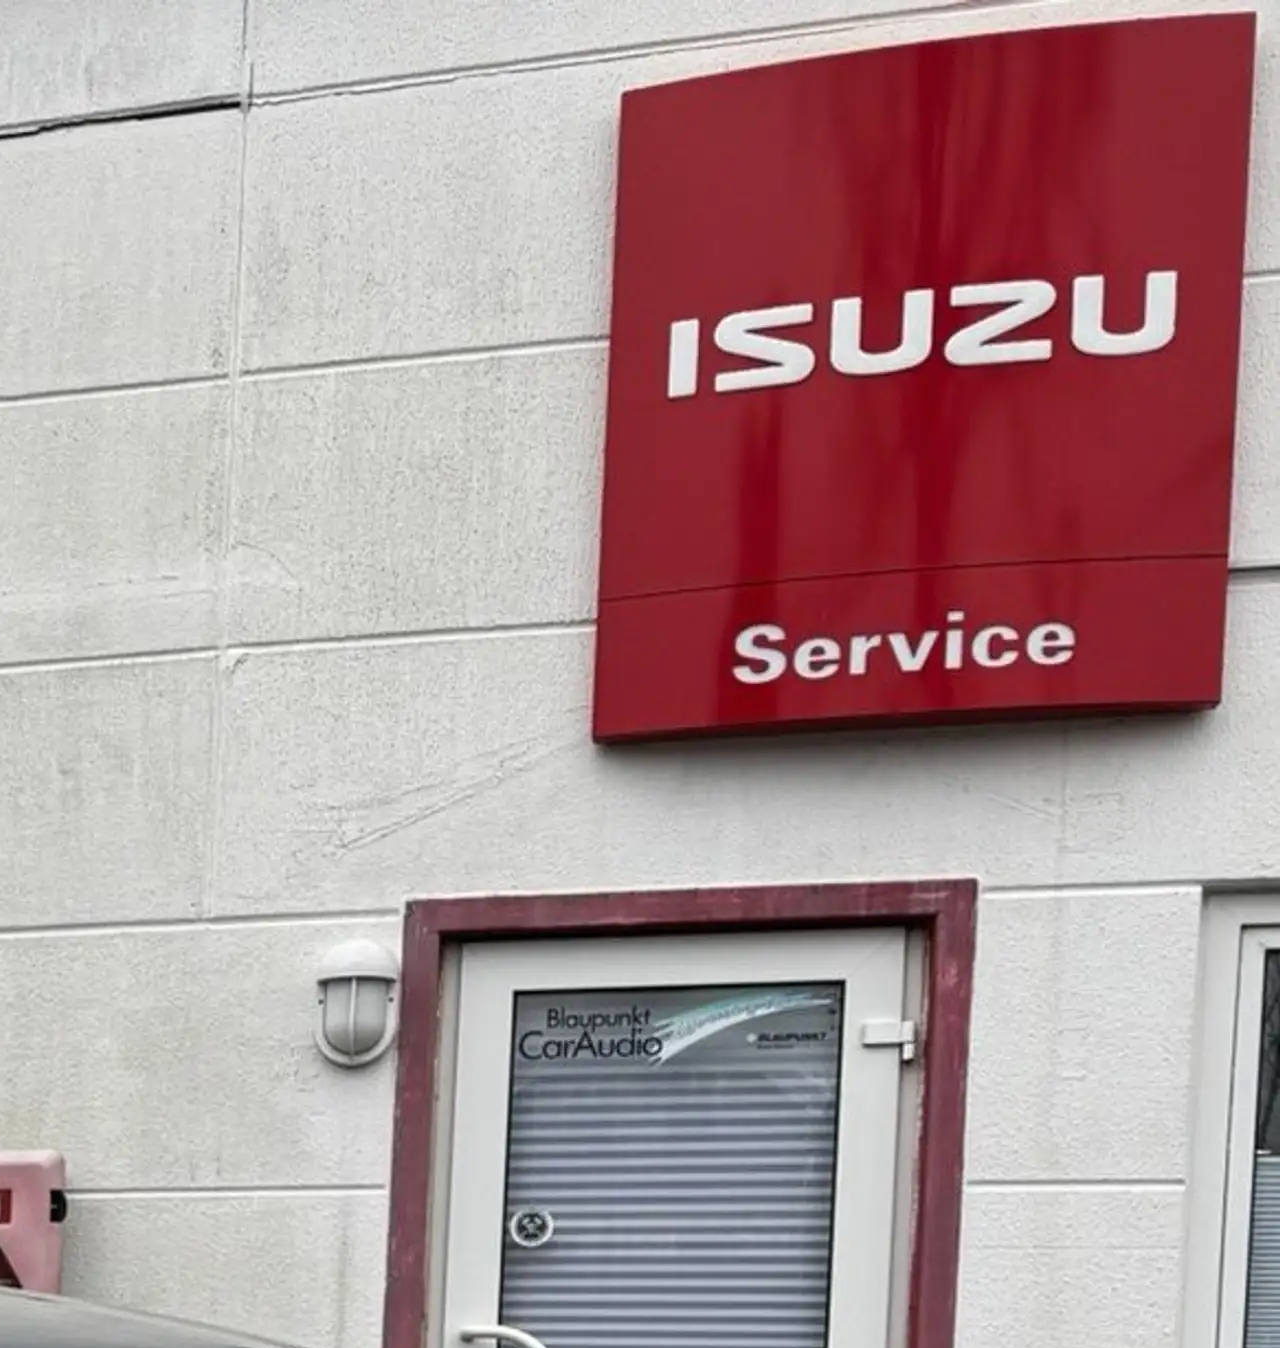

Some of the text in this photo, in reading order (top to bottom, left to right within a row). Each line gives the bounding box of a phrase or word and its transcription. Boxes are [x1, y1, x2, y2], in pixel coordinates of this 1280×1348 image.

[667, 270, 1178, 398] ISUZU
[732, 611, 1076, 684] Service
[519, 1028, 663, 1060] CarAudio
[547, 1004, 651, 1032] Blaupunkt
